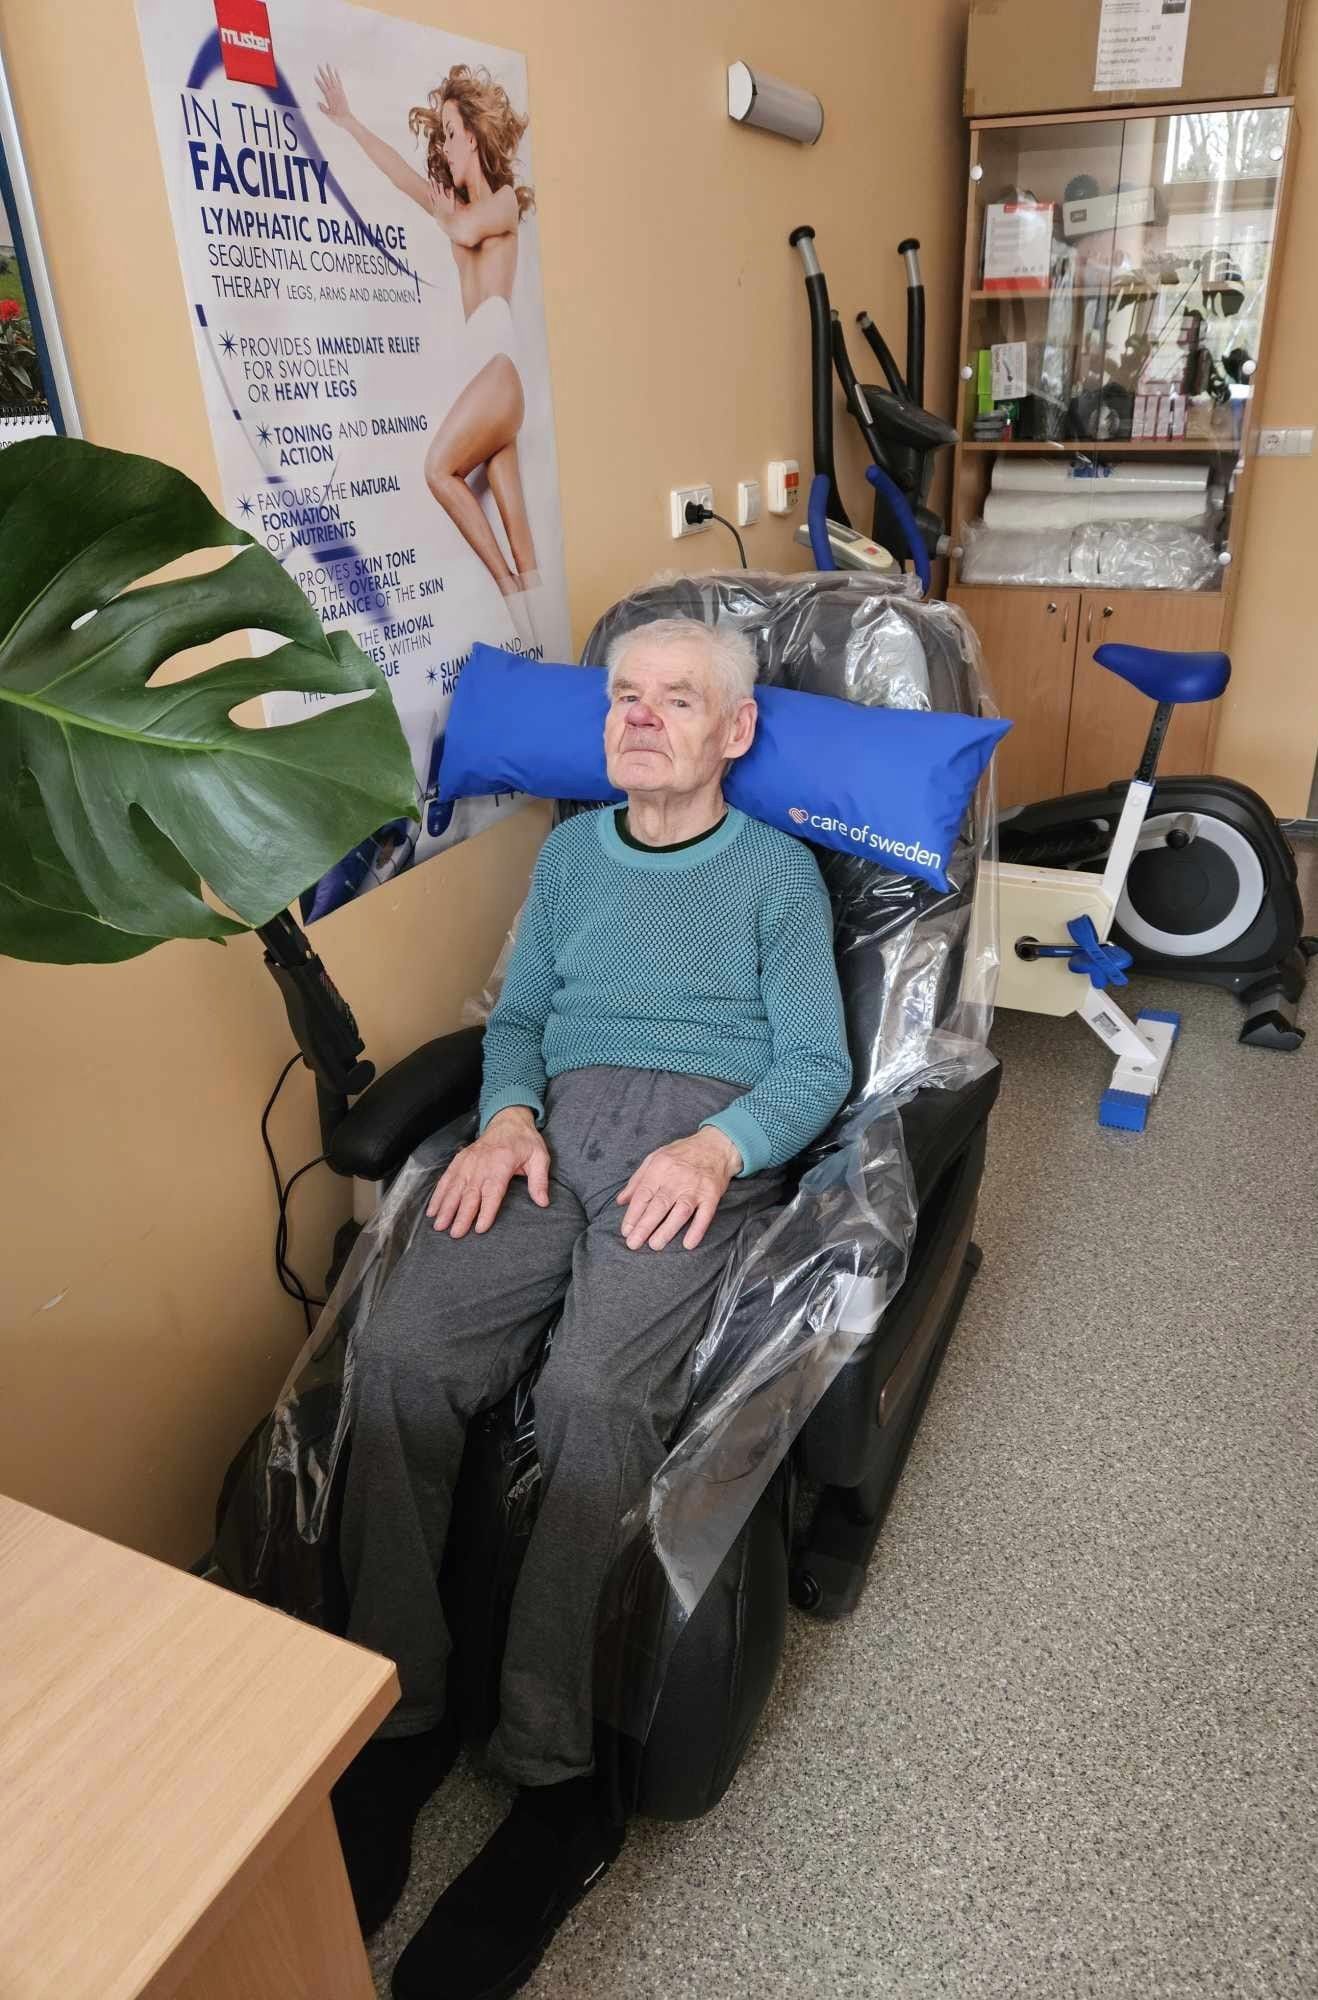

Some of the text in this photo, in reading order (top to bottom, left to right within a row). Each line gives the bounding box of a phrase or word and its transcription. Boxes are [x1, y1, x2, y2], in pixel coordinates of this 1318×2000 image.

[221, 28, 270, 52] muster
[181, 94, 298, 151] IN THIS
[188, 141, 328, 204] FACILITY
[201, 206, 407, 249] LYMPHATIC DRAINAGE
[208, 243, 410, 276] SEQUENTIAL COMPRESSION
[211, 275, 280, 299] THERAPY
[287, 285, 316, 302] LEGS,
[320, 286, 347, 301] ARMS
[350, 288, 370, 301] AND
[240, 336, 421, 357] PROVIDES IMMEDIATE RELIEF
[244, 359, 350, 380] FOR SWOLLEN
[248, 379, 358, 403] OR HEAVY LEGS
[274, 414, 428, 445] TONING AND DRAINING
[279, 444, 334, 467] ACTION
[257, 475, 401, 513] FAVOURS THE NATURAL
[262, 503, 341, 532] FORMATION
[267, 521, 357, 551] OF NUTRIENTS
[294, 549, 416, 588] PROVES SKIN TONE
[315, 577, 445, 622] ARANCE OF THE SKIN
[320, 583, 345, 602] THE
[350, 571, 401, 596] OVERALL
[357, 614, 435, 648] THE REMOVAL
[389, 632, 432, 657] WITHIN
[380, 660, 400, 677] SUE
[811, 814, 941, 869] care of sweden
